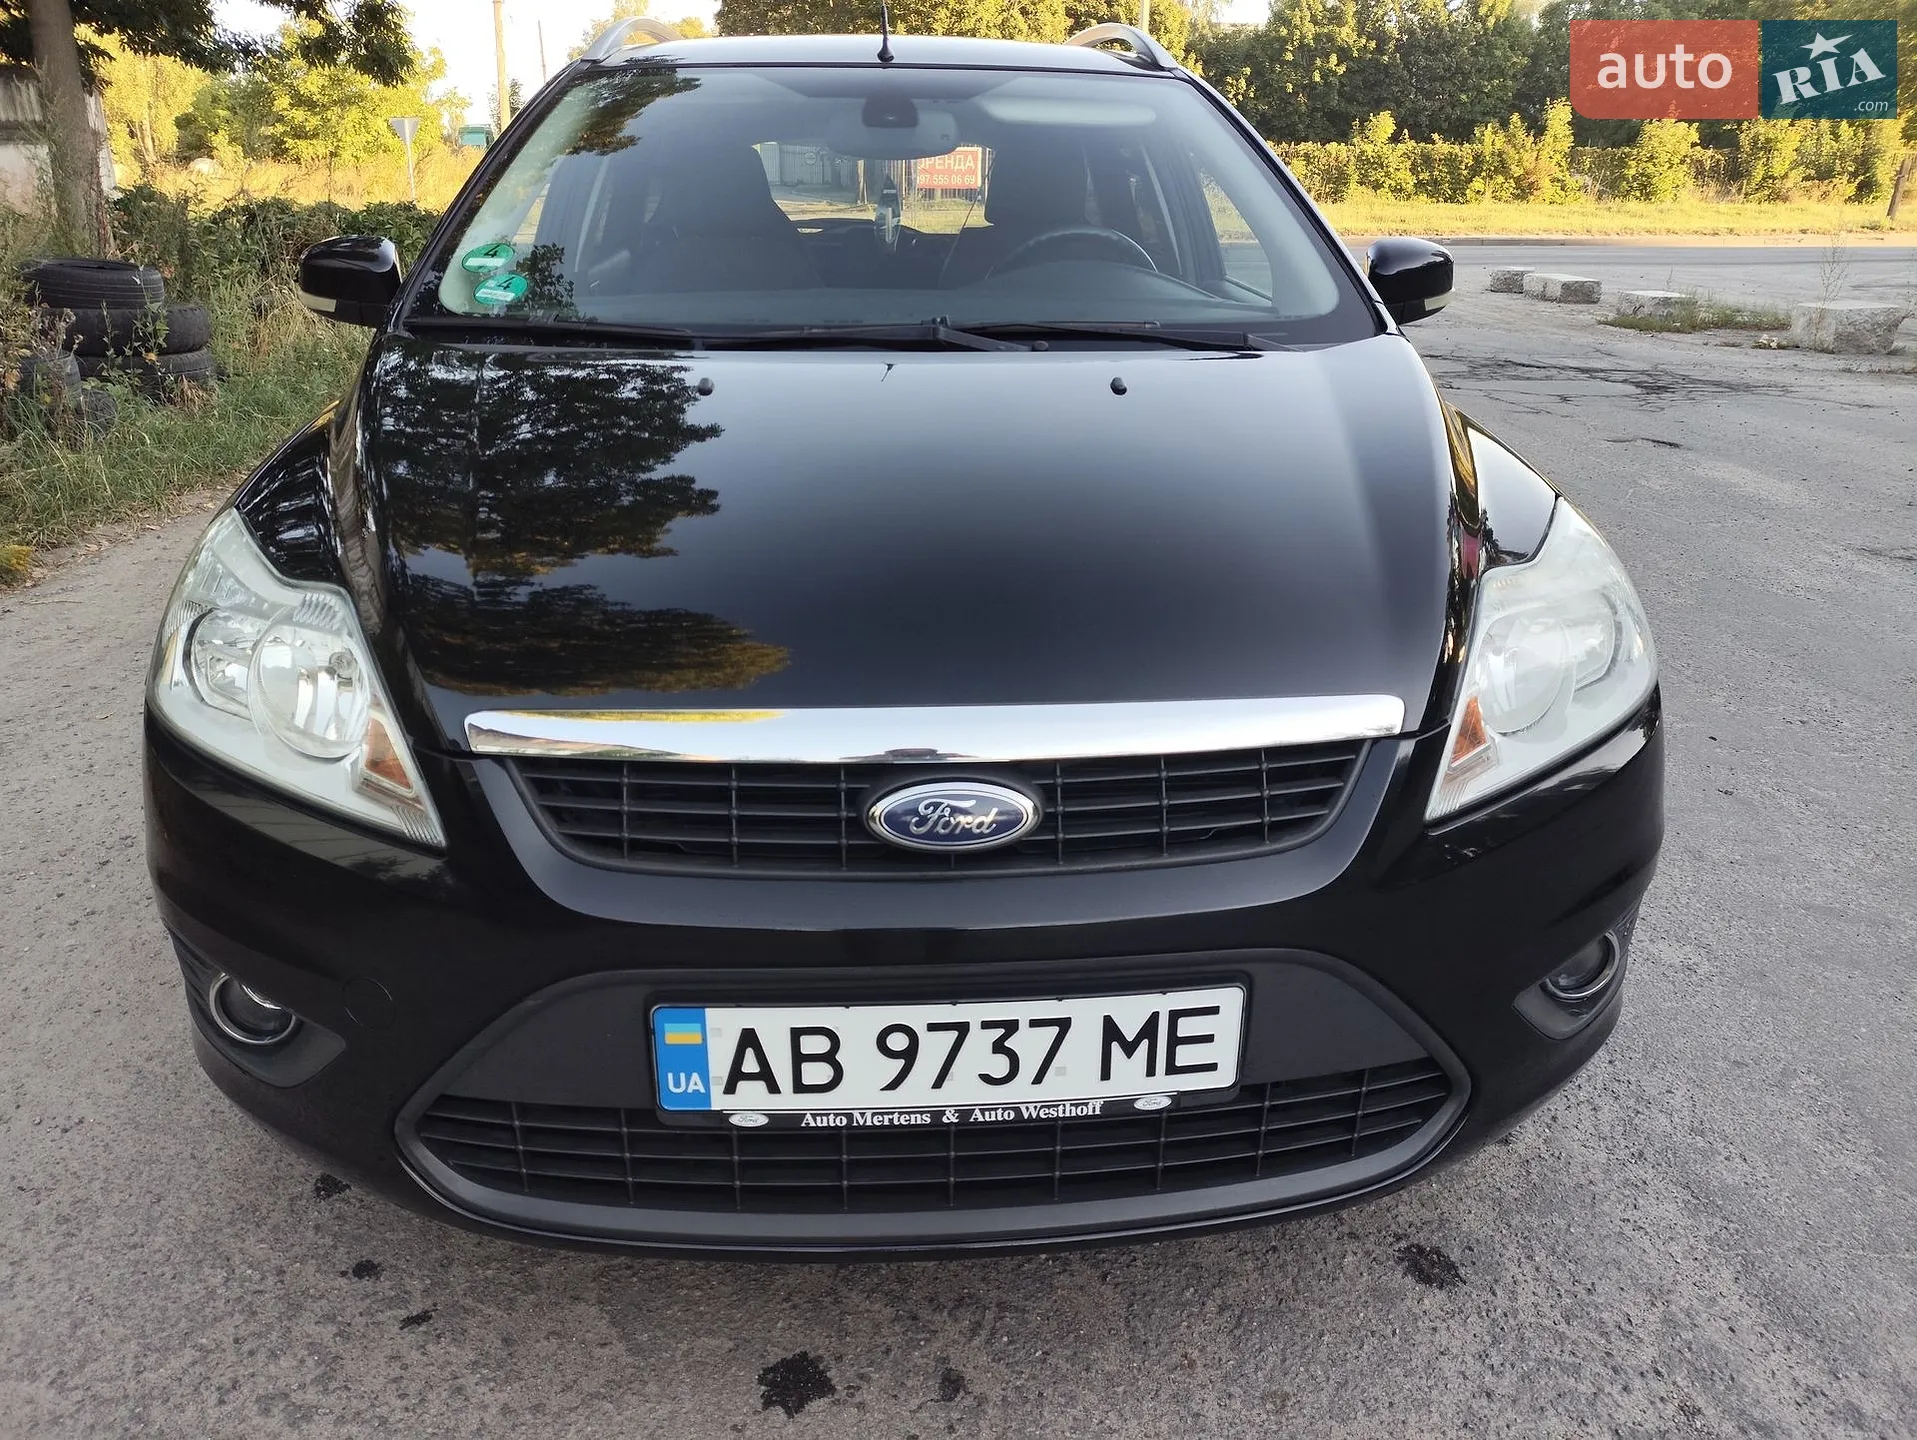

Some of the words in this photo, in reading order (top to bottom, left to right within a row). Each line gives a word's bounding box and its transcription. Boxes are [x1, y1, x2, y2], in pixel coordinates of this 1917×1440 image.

[932, 174, 949, 185] 555
[951, 174, 962, 185] 06
[964, 175, 975, 185] 69
[497, 276, 516, 291] 4
[909, 798, 999, 835] Ford
[722, 1026, 844, 1095] AB
[876, 1016, 1072, 1092] 9737
[1099, 1005, 1220, 1082] ME
[667, 1072, 706, 1094] UA
[801, 1113, 847, 1128] Auto
[852, 1110, 931, 1127] Mertens
[942, 1109, 959, 1123] &
[969, 1107, 1015, 1122] Auto
[1020, 1101, 1104, 1120] Westhoff
